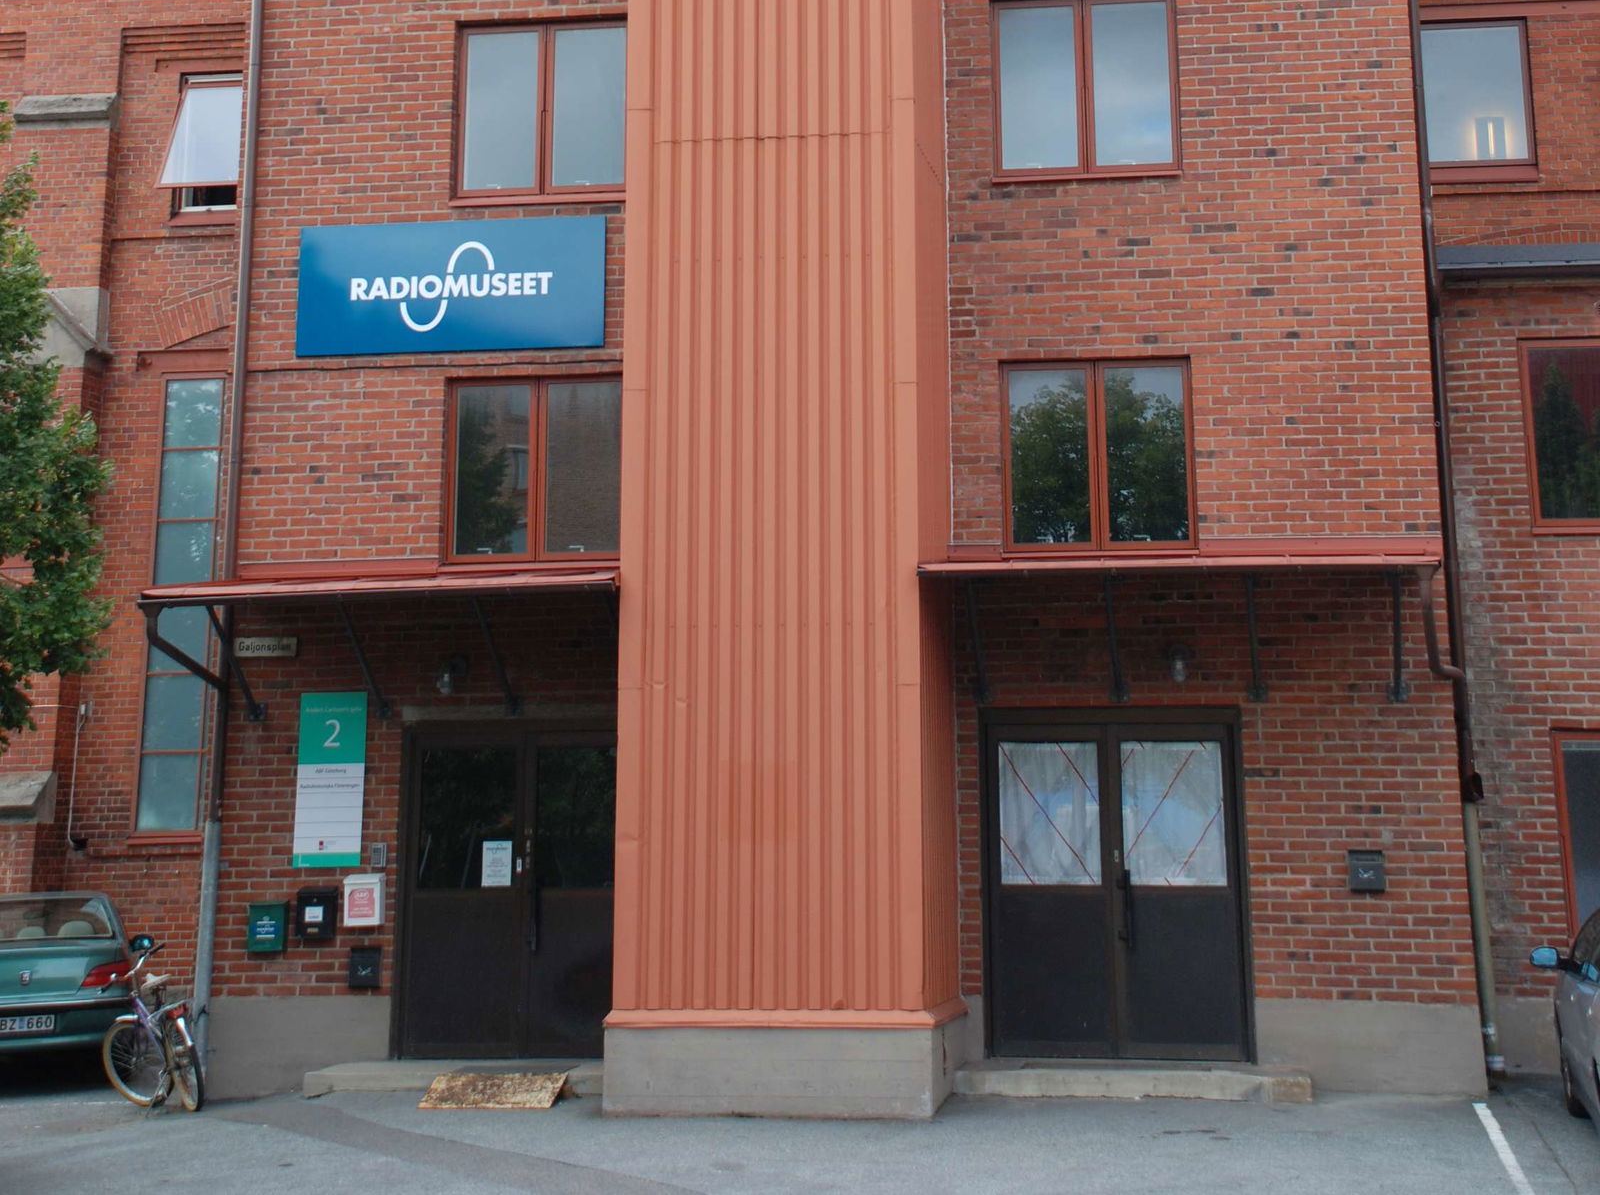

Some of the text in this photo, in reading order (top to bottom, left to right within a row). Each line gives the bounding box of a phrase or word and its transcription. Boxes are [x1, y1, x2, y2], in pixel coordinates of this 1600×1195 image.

[350, 272, 554, 301] RADIOMUSEET
[322, 719, 341, 748] 2
[26, 1016, 53, 1029] 660
